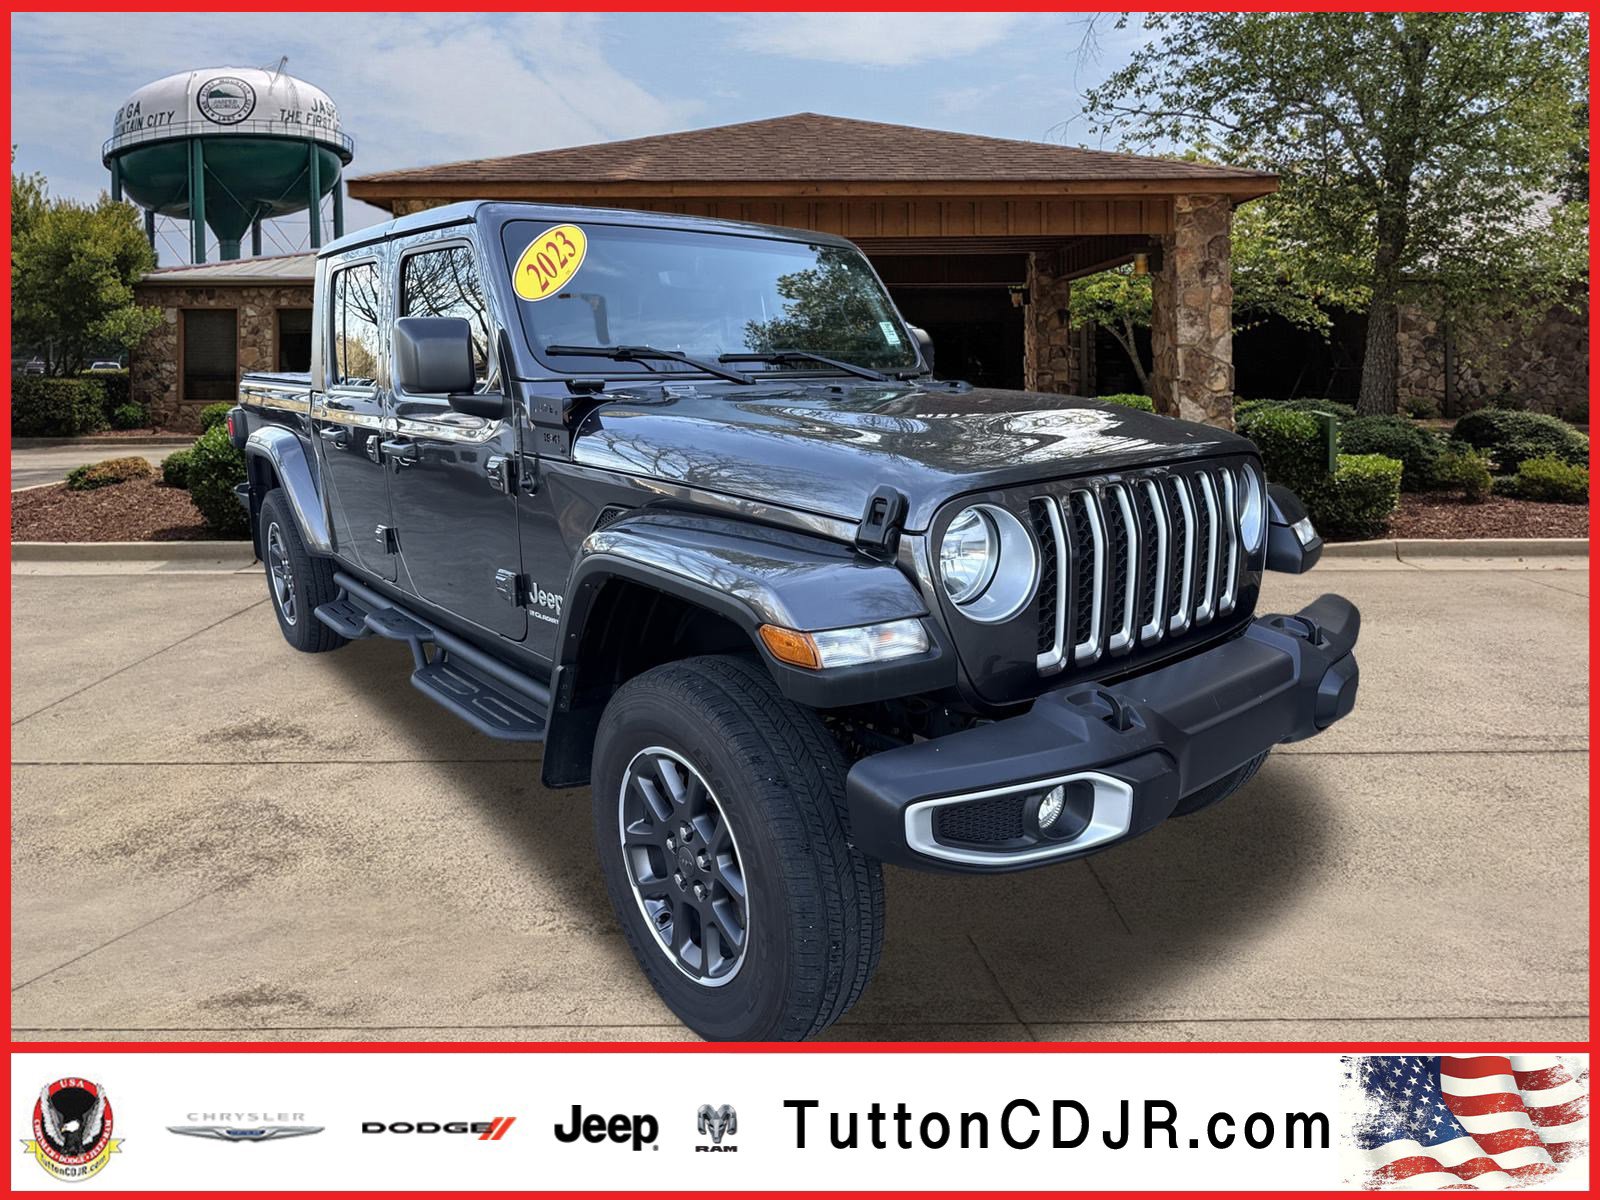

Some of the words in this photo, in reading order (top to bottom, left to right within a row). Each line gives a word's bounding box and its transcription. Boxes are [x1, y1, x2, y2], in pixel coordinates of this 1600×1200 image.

[126, 101, 141, 119] GA
[147, 110, 176, 128] CITY
[280, 109, 302, 124] THE
[306, 112, 332, 129] FIRST
[526, 231, 576, 293] 2023
[529, 582, 563, 616] Jeep
